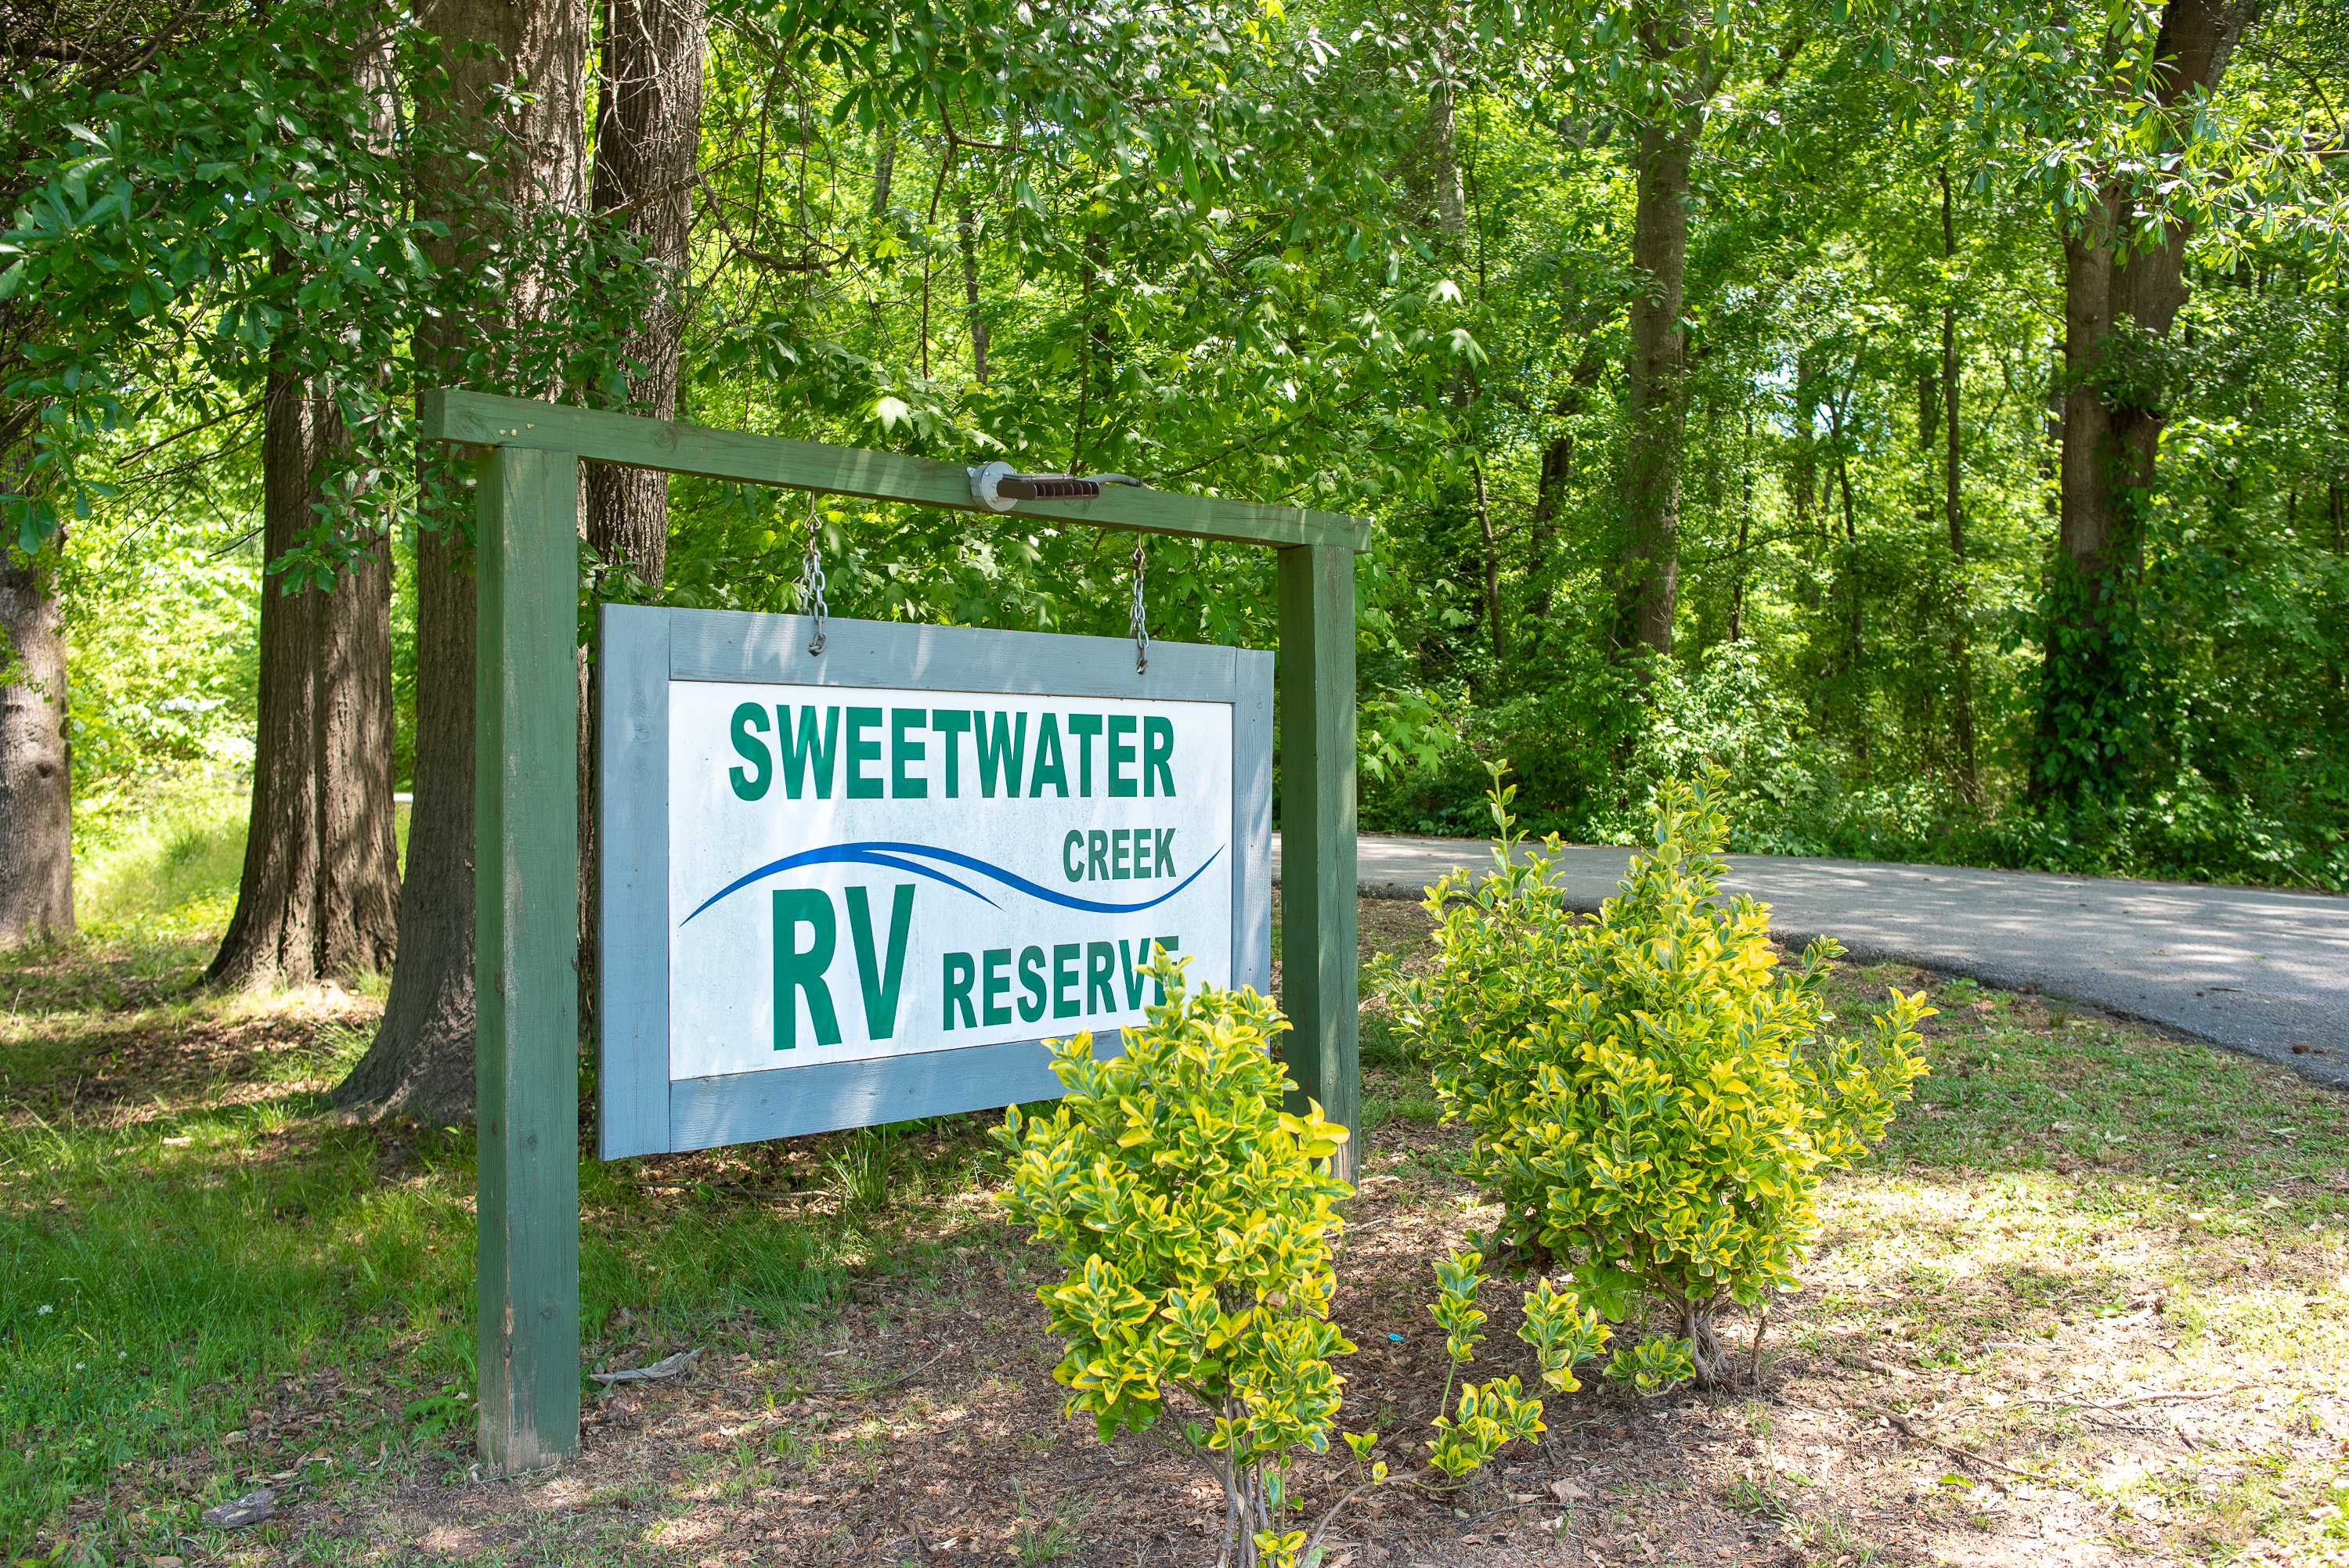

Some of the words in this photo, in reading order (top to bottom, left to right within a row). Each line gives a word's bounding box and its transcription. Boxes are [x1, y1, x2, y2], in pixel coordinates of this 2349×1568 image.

[729, 702, 1177, 802] SWEETWATER
[1063, 827, 1177, 883] CREEK
[773, 884, 915, 1051] RV
